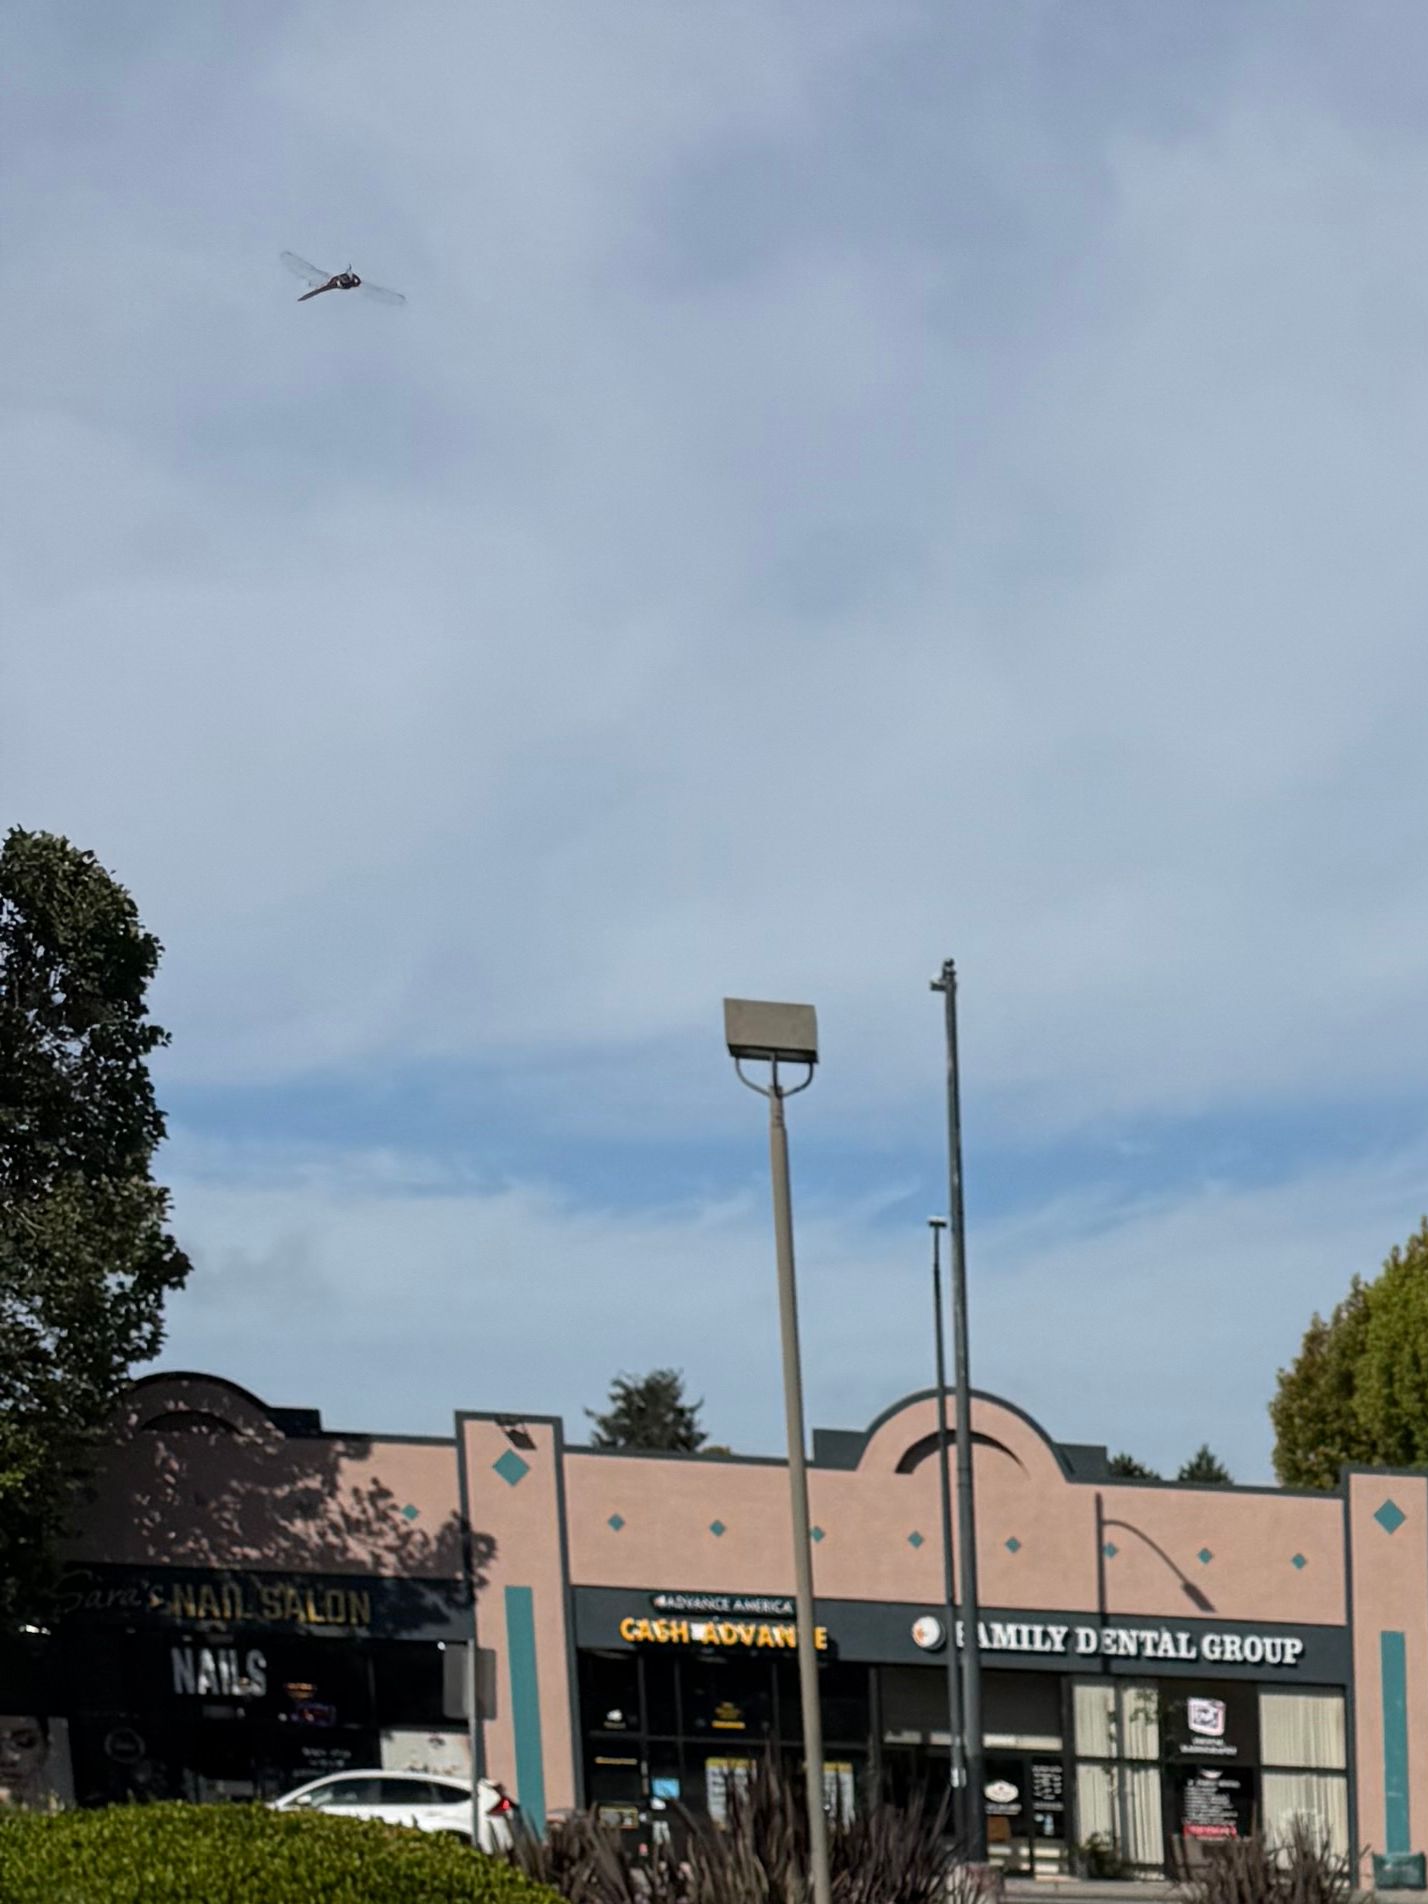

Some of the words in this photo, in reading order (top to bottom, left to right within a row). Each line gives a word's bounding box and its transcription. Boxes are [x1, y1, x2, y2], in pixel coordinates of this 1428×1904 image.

[171, 1583, 252, 1621] NAIL
[262, 1584, 371, 1625] SALON
[732, 1599, 794, 1615] AMERICA
[619, 1617, 689, 1643] CASH
[700, 1621, 828, 1650] ADVANE
[1076, 1627, 1197, 1660] DENTAL
[1202, 1635, 1302, 1665] GROUP
[171, 1647, 267, 1696] NAILS
